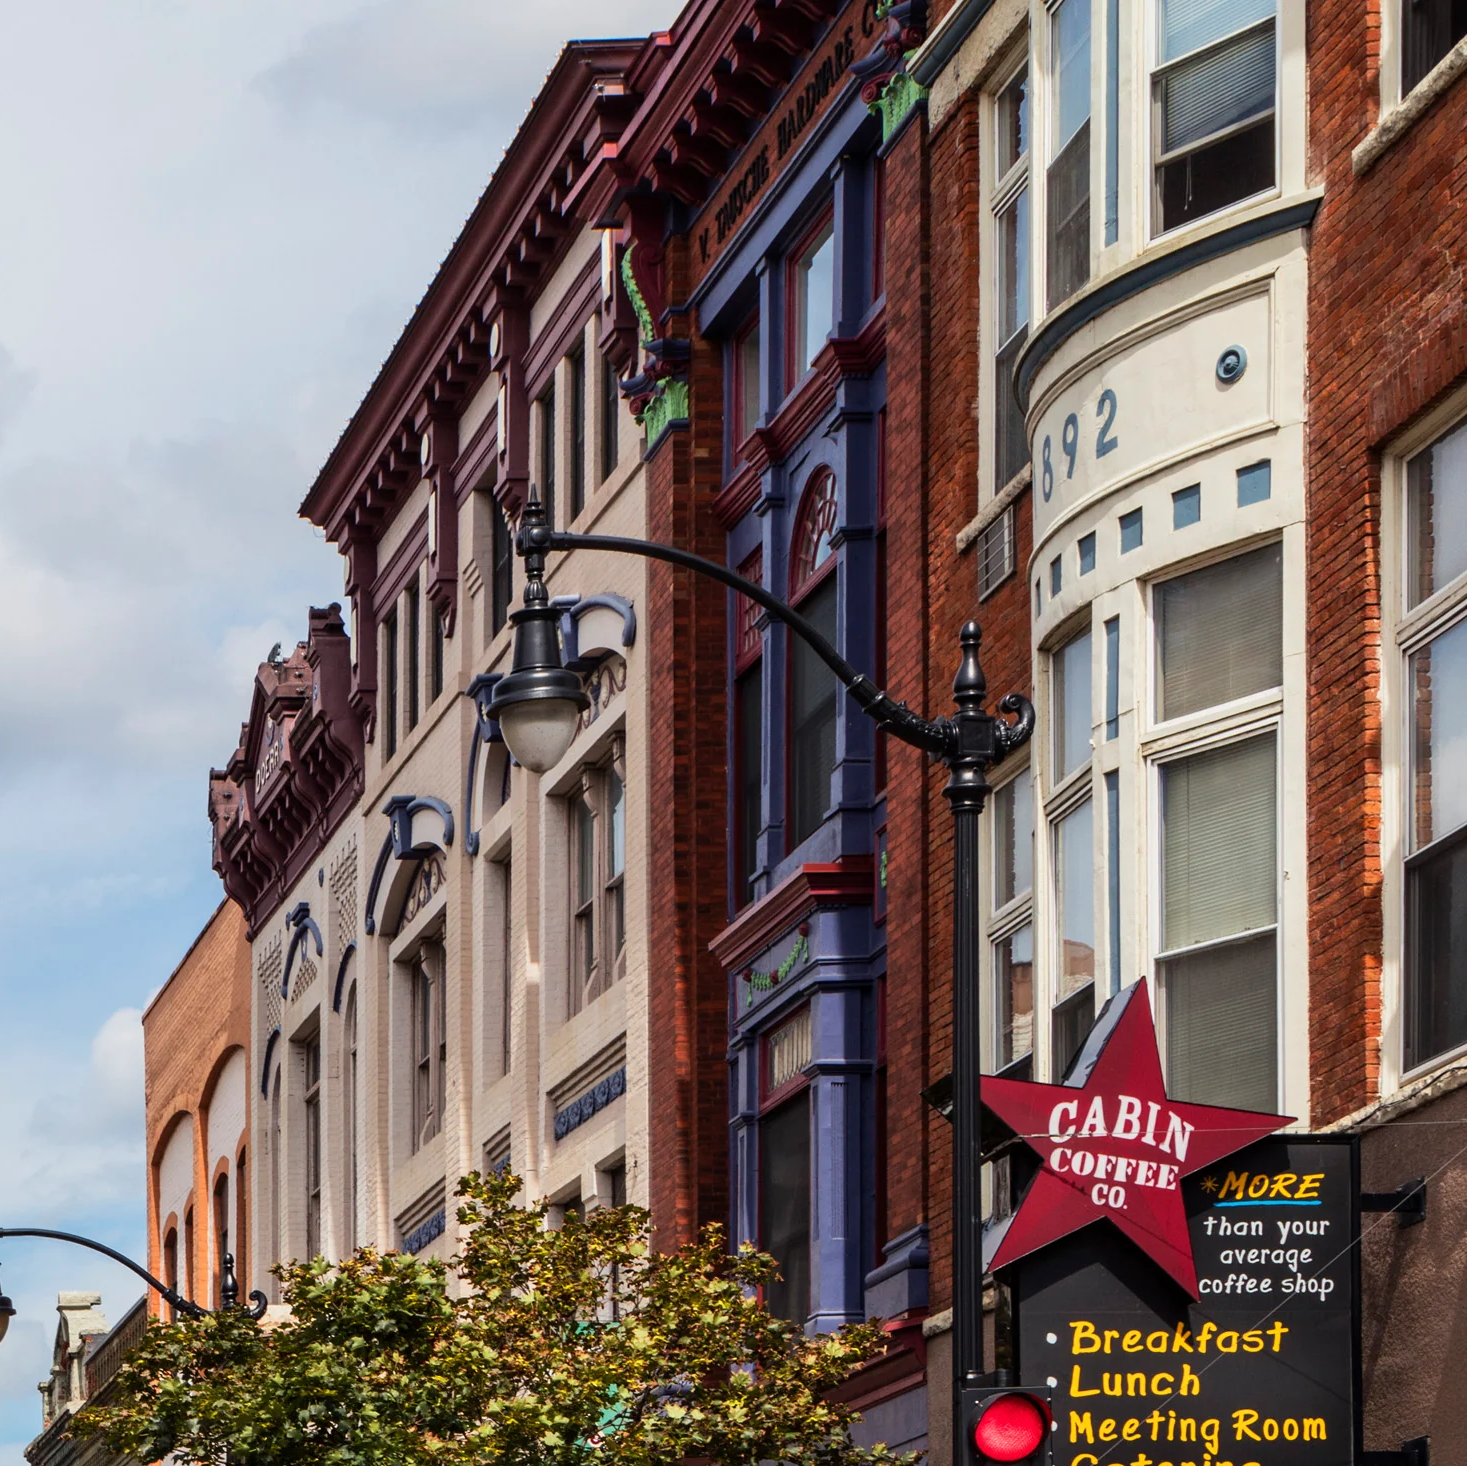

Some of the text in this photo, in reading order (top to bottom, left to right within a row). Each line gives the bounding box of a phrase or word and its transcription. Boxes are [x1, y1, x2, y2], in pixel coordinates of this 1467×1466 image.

[777, 26, 856, 160] HARDWARE
[1032, 387, 1119, 504] 892
[1048, 1094, 1195, 1162] CABIN
[1049, 1147, 1179, 1191] COFFEE
[1091, 1183, 1128, 1210] CO.
[1203, 1216, 1330, 1245] than your
[1220, 1249, 1313, 1272] average
[1198, 1273, 1335, 1301] coffee shop
[1069, 1321, 1289, 1355] Breakfast
[1069, 1364, 1200, 1398] Lunch
[1069, 1409, 1327, 1455] Meeting Room
